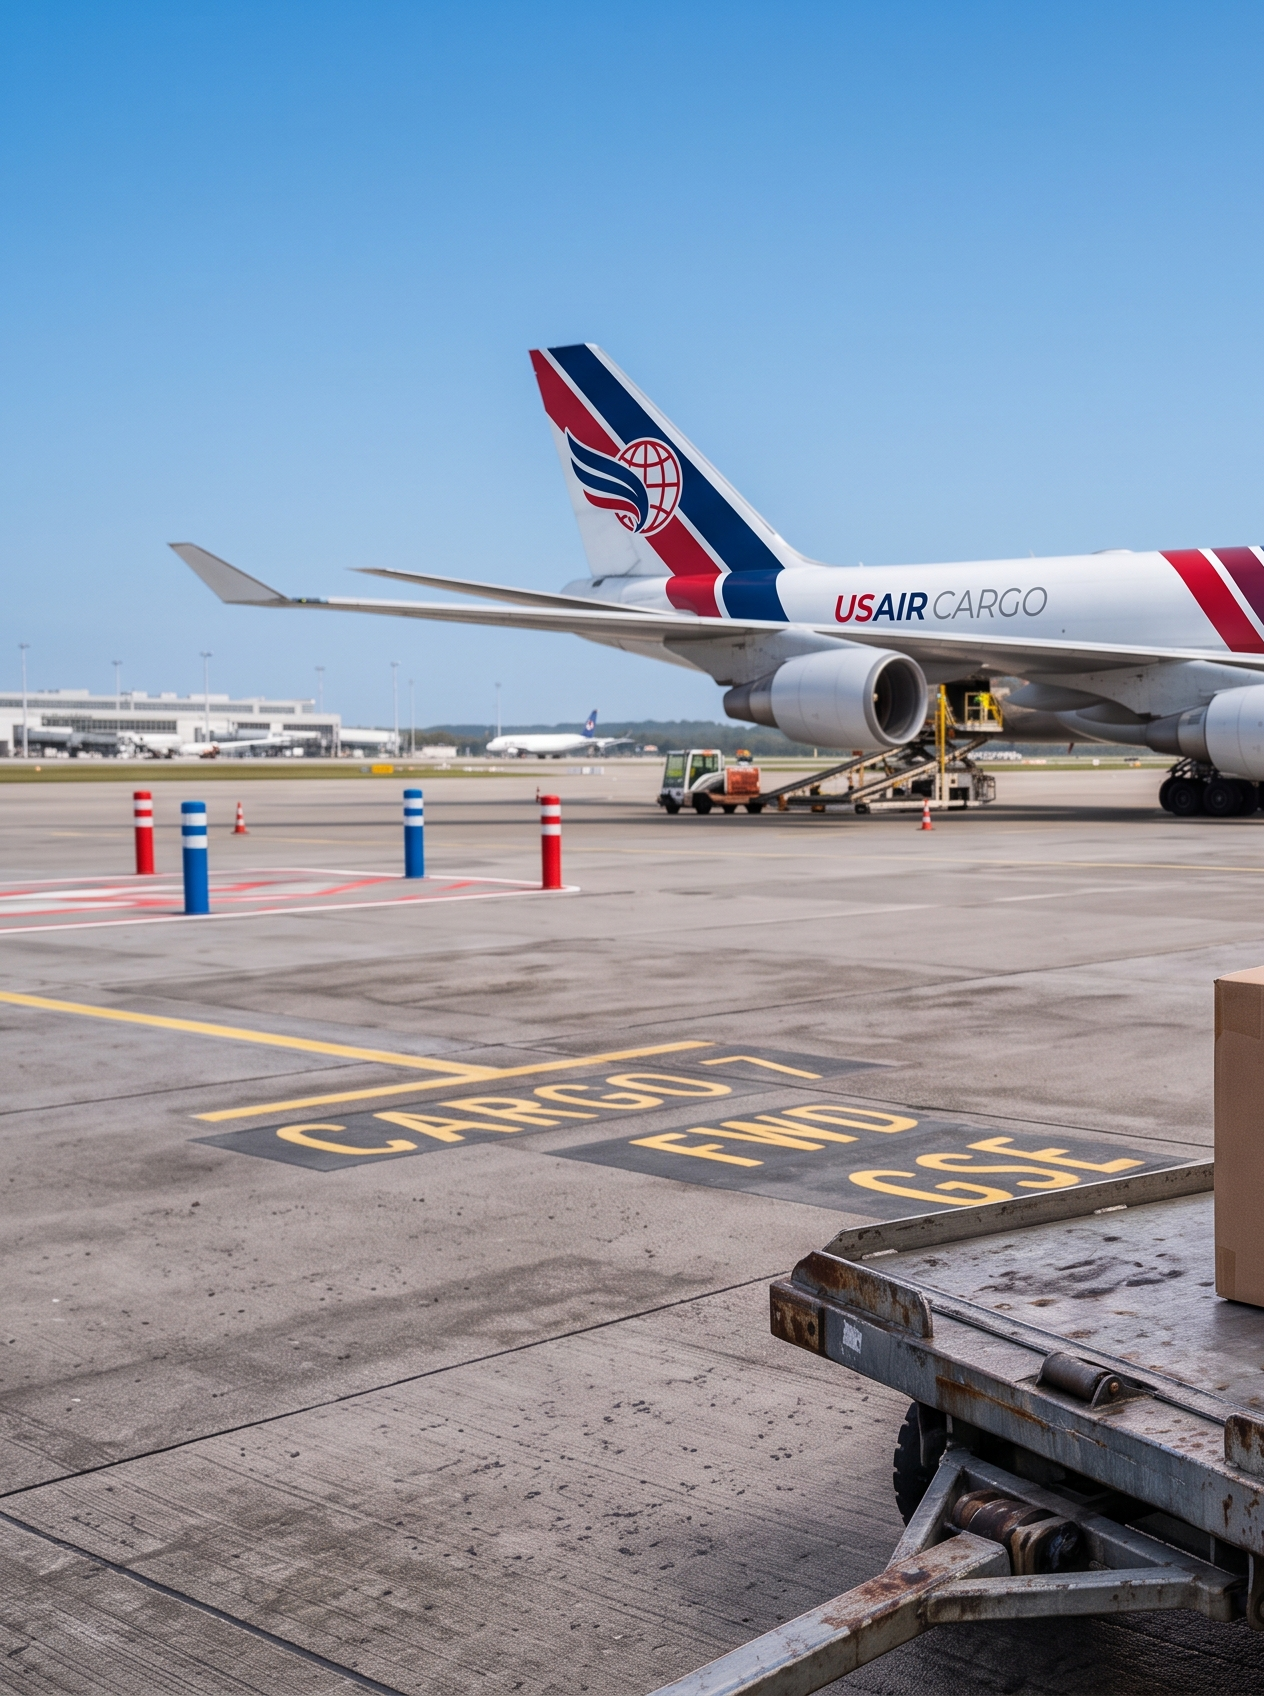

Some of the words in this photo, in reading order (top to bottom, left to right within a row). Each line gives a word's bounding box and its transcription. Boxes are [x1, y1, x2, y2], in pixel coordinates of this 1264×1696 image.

[834, 592, 928, 623] USAIR
[933, 587, 1048, 620] CARGO
[276, 1073, 732, 1156] CARGO
[628, 1103, 918, 1168] FWD
[848, 1136, 1146, 1207] GSE
